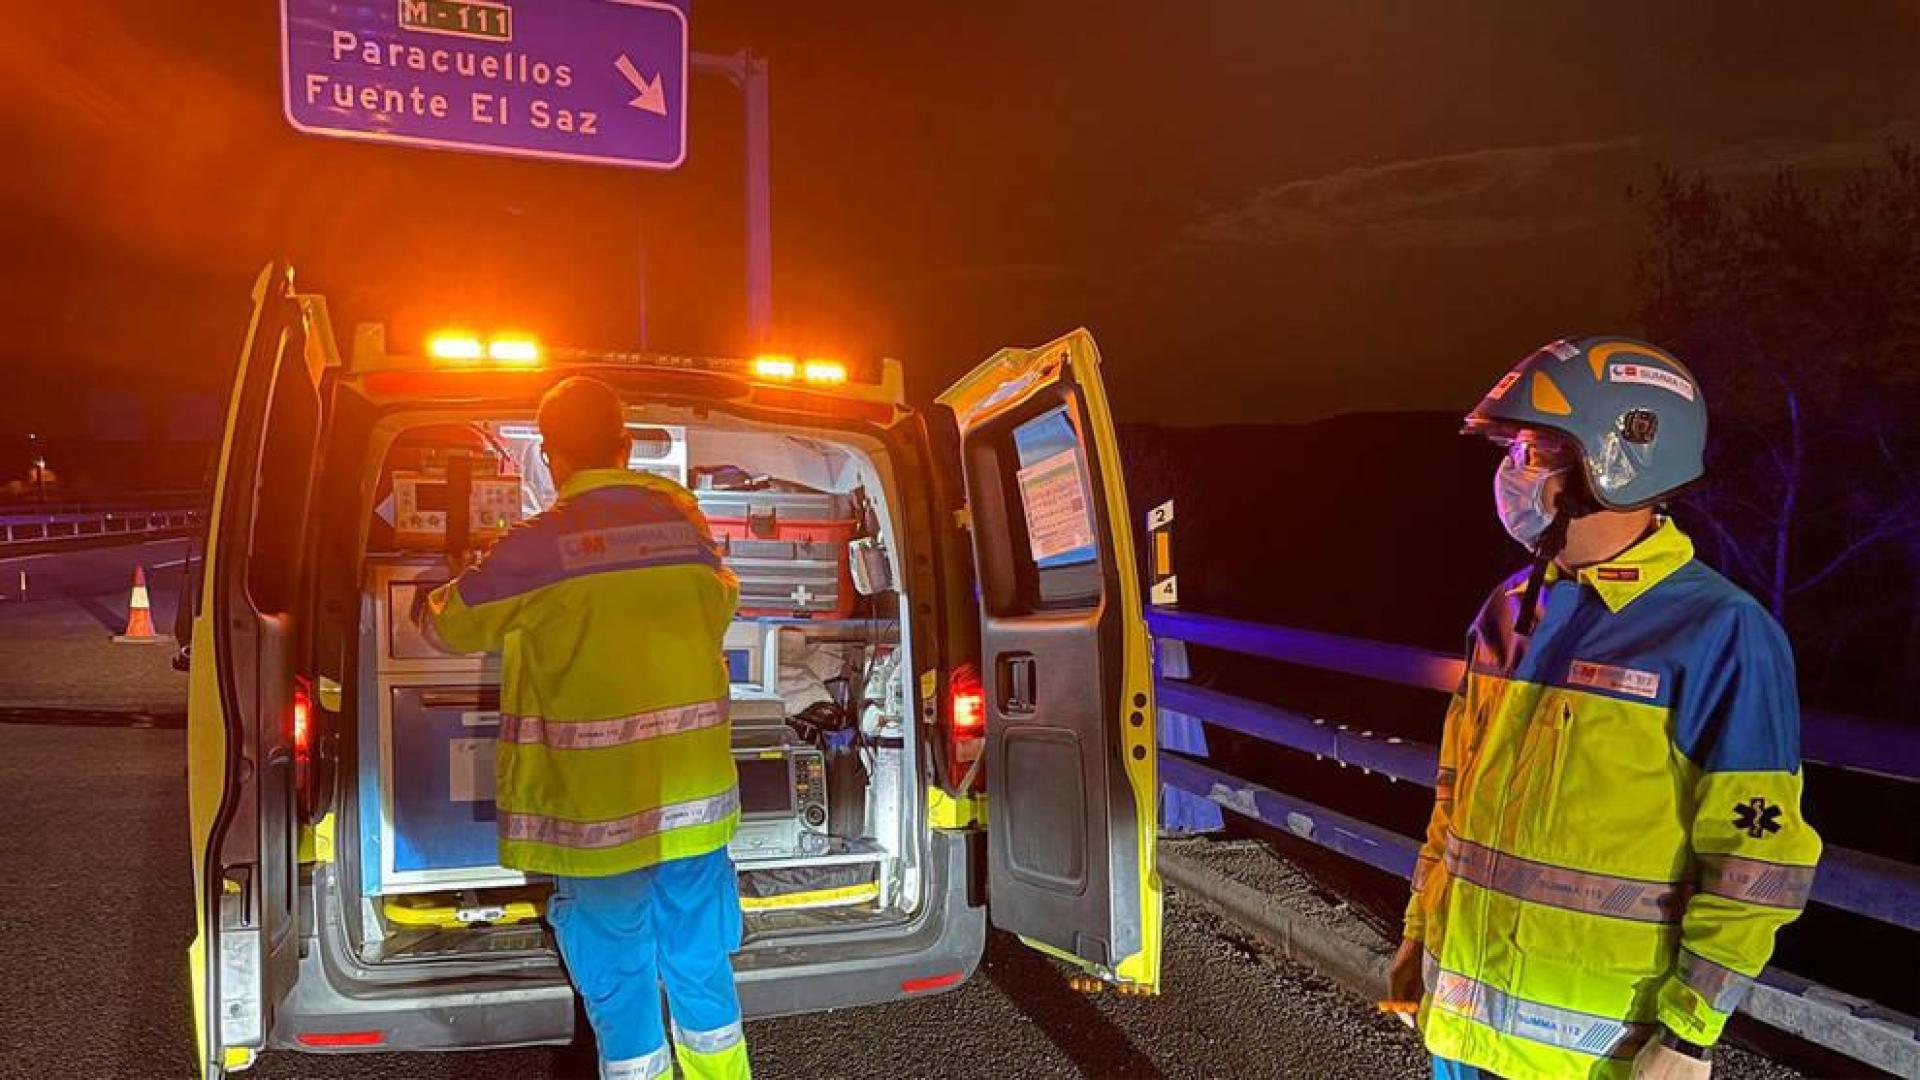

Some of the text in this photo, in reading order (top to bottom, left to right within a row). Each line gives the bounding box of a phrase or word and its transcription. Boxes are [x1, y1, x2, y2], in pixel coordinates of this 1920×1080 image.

[404, 0, 505, 33] M-111
[333, 30, 572, 88] Paracuellos
[306, 74, 598, 135] Fuente El Saz
[1156, 509, 1165, 522] 2
[1163, 582, 1173, 594] 4
[1520, 1014, 1557, 1030] SUMMA
